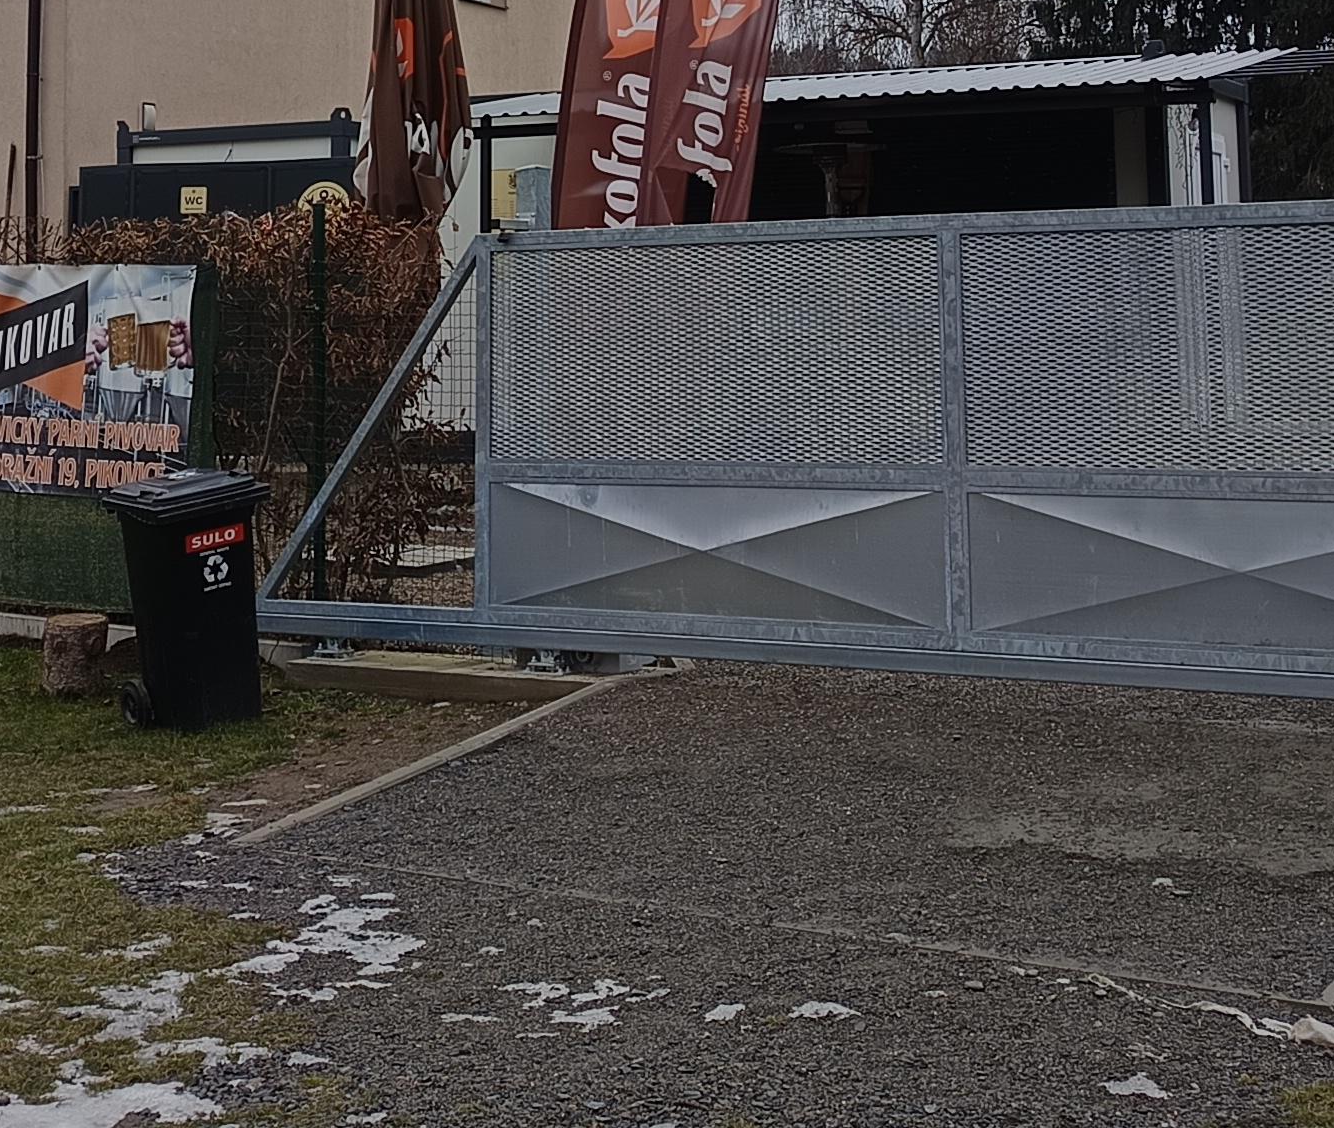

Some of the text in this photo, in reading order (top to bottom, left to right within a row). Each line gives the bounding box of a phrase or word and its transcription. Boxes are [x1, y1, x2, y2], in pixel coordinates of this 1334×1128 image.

[184, 196, 204, 205] WC
[104, 420, 180, 453] PIVOVAR
[191, 529, 236, 549] SULO
